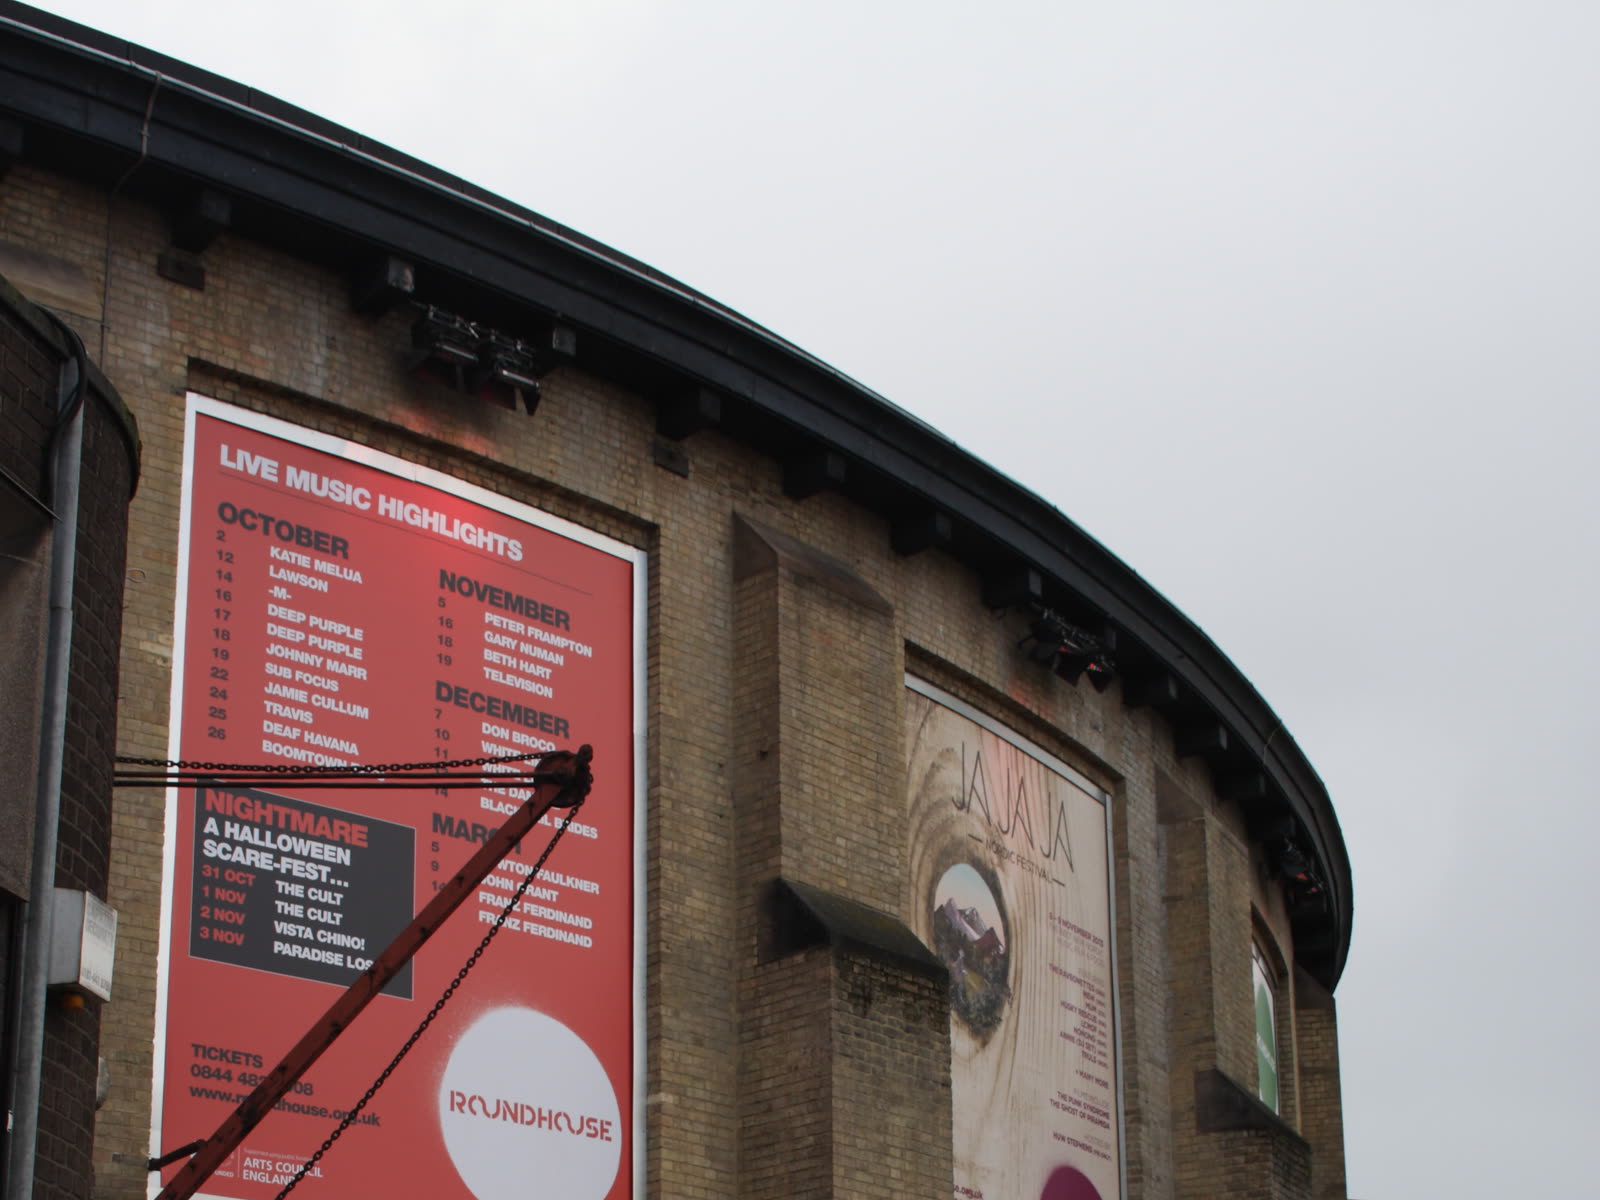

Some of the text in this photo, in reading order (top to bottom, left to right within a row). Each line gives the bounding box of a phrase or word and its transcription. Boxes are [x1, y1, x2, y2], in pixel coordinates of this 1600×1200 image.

[220, 443, 524, 561] LIVE MUSIC HIGHLIGHTS
[217, 502, 349, 559] OCTOBER
[216, 530, 363, 584] 2 KATIE MELUA
[217, 550, 329, 592] 12 LAWSON
[216, 570, 292, 600] 14 -M-
[439, 569, 570, 632] NOVEMBER
[214, 608, 363, 660] 17 DEEP PURPLE
[215, 589, 364, 642] 16 DEEP PURPLE
[438, 597, 593, 658] 5 PETER FRAMPTON
[213, 628, 367, 681] 18 JOHNNY MARR
[437, 634, 552, 679] 18 BETH HART
[438, 616, 564, 666] 16 GARY NUMAN
[212, 648, 339, 692] 19 SUB FOCUS
[437, 653, 553, 698] 19 TELEVISION
[209, 686, 313, 724] 24 TRAVIS
[210, 666, 369, 720] 22 JAMIE CULLUM
[436, 680, 570, 739] DECEMBER
[207, 726, 226, 740] 26
[208, 706, 359, 756] 25 DEAF HAVANA
[434, 709, 556, 752] 7 DON BROCO
[434, 728, 450, 740] 10
[434, 747, 449, 759] 11
[205, 788, 368, 848] NIGHTMARE
[203, 817, 351, 866] A HALLOWEEN
[202, 864, 343, 906] 31 OCT THE CULT
[431, 861, 439, 872] 9
[432, 841, 440, 852] 5
[537, 868, 600, 895] FAULKNER
[1016, 854, 1052, 883] FESTIVAL
[202, 885, 343, 926] 1 NOV THE CULT
[523, 902, 593, 930] FERDINAND
[199, 926, 373, 971] 3 NOV PARADISE LOS
[200, 906, 366, 951] 2 NOV VISTA CHINO!
[523, 921, 593, 948] FERDINAND
[190, 1064, 233, 1083] 0844
[191, 1043, 263, 1068] TICKETS
[450, 1090, 612, 1142] ROUNDHOUSE
[243, 1157, 273, 1172] ARTS
